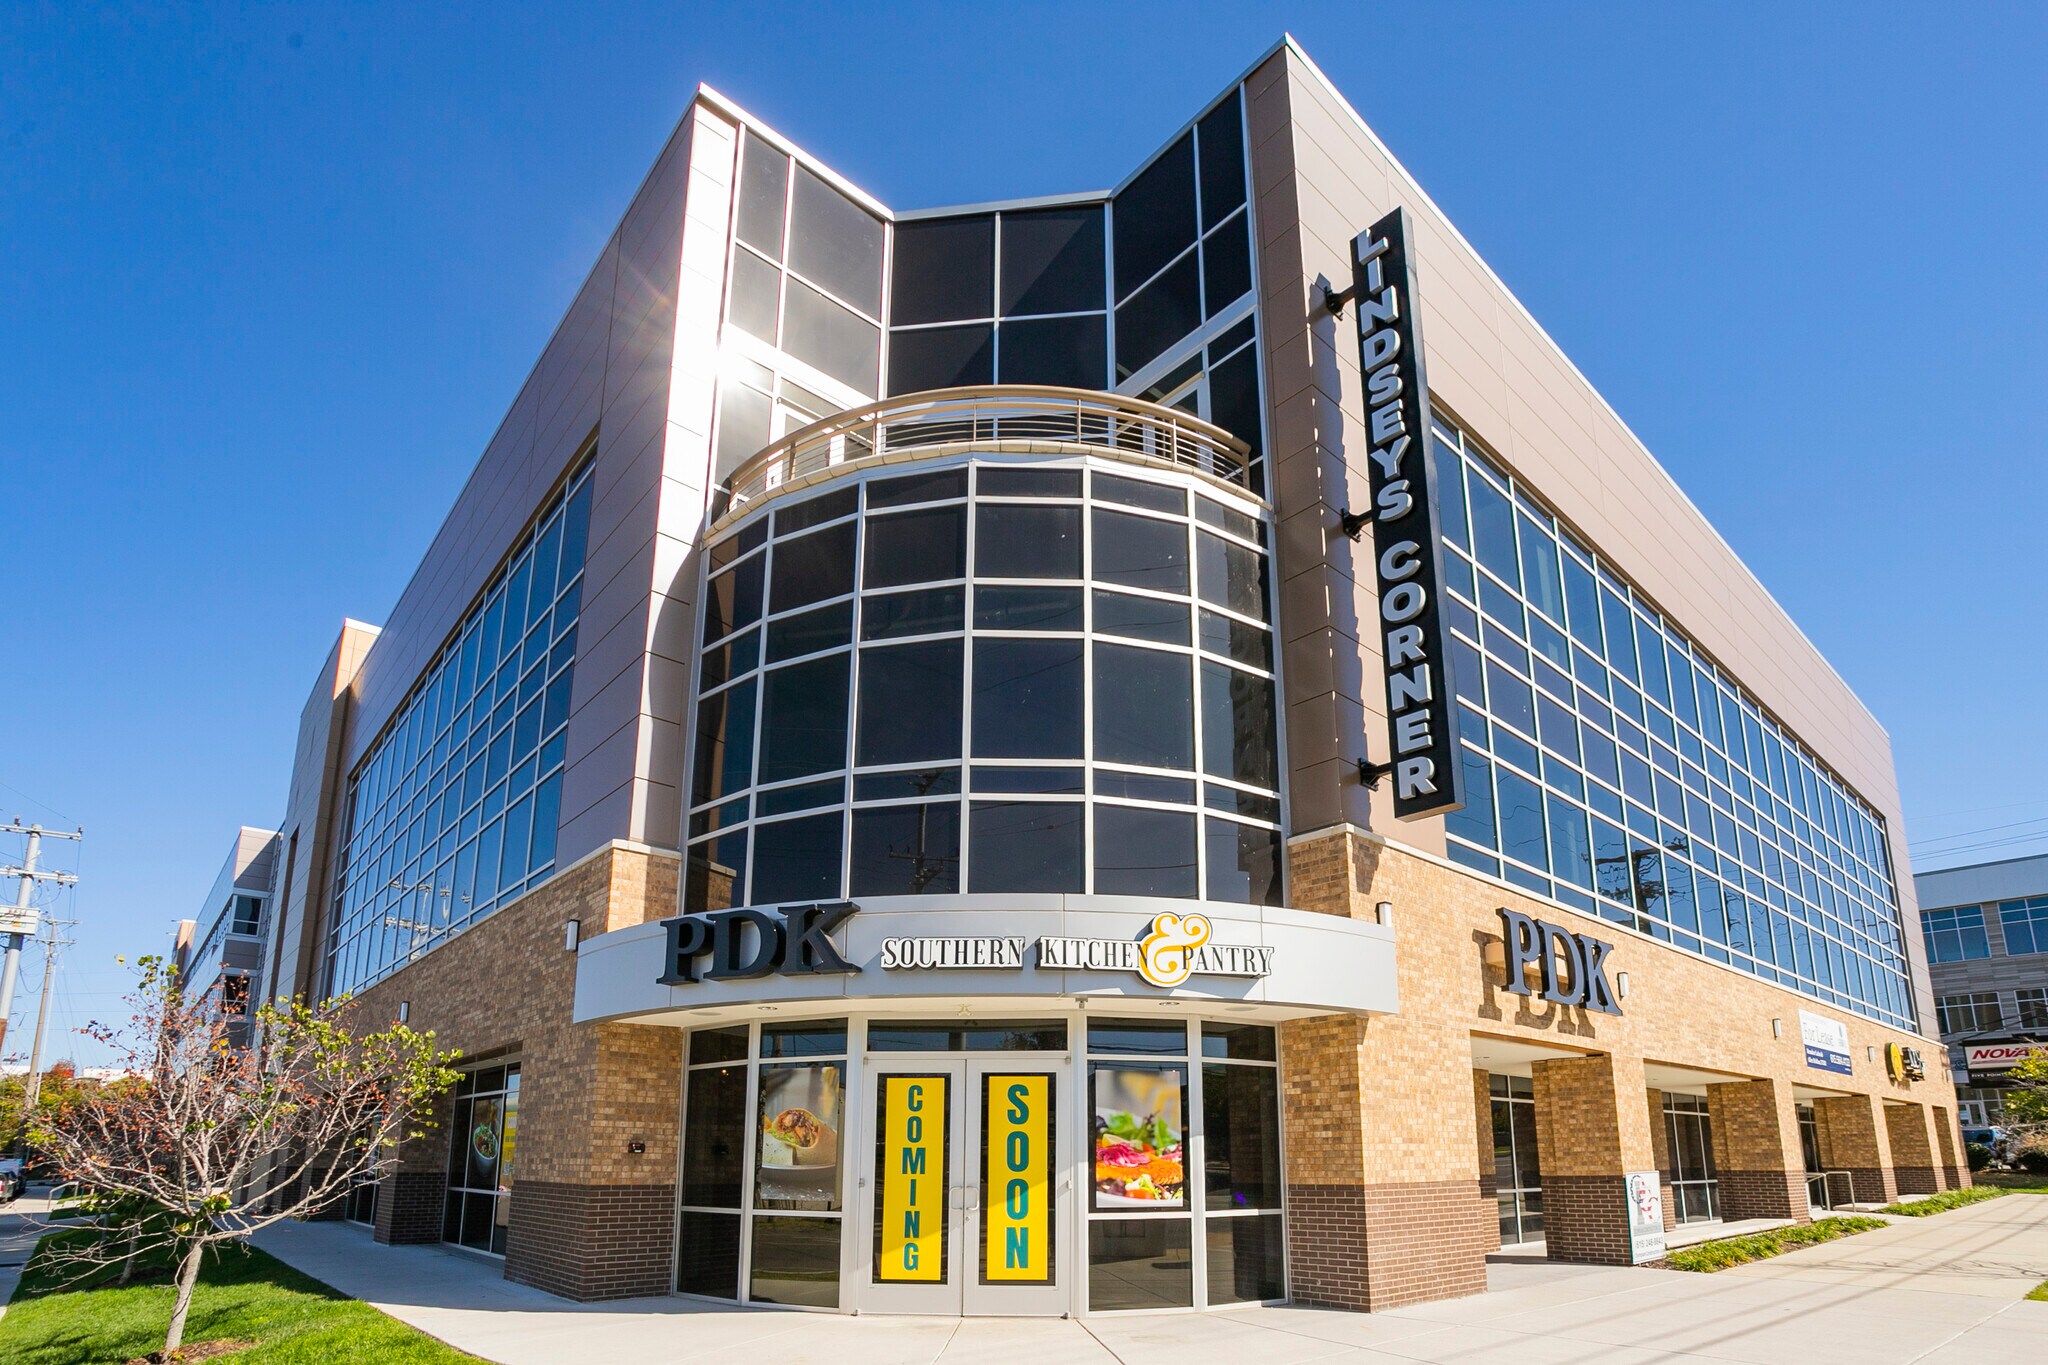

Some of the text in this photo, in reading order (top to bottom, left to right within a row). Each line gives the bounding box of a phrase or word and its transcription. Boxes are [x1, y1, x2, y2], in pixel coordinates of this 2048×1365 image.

[1356, 229, 1440, 802] LINDSEYS CORNER
[657, 901, 862, 986] PDK
[883, 914, 1272, 985] SOUTHERN KITCHEN & PANTRY
[1496, 907, 1624, 1016] PDK
[902, 1085, 926, 1271] COMING
[1006, 1084, 1029, 1269] SOON
